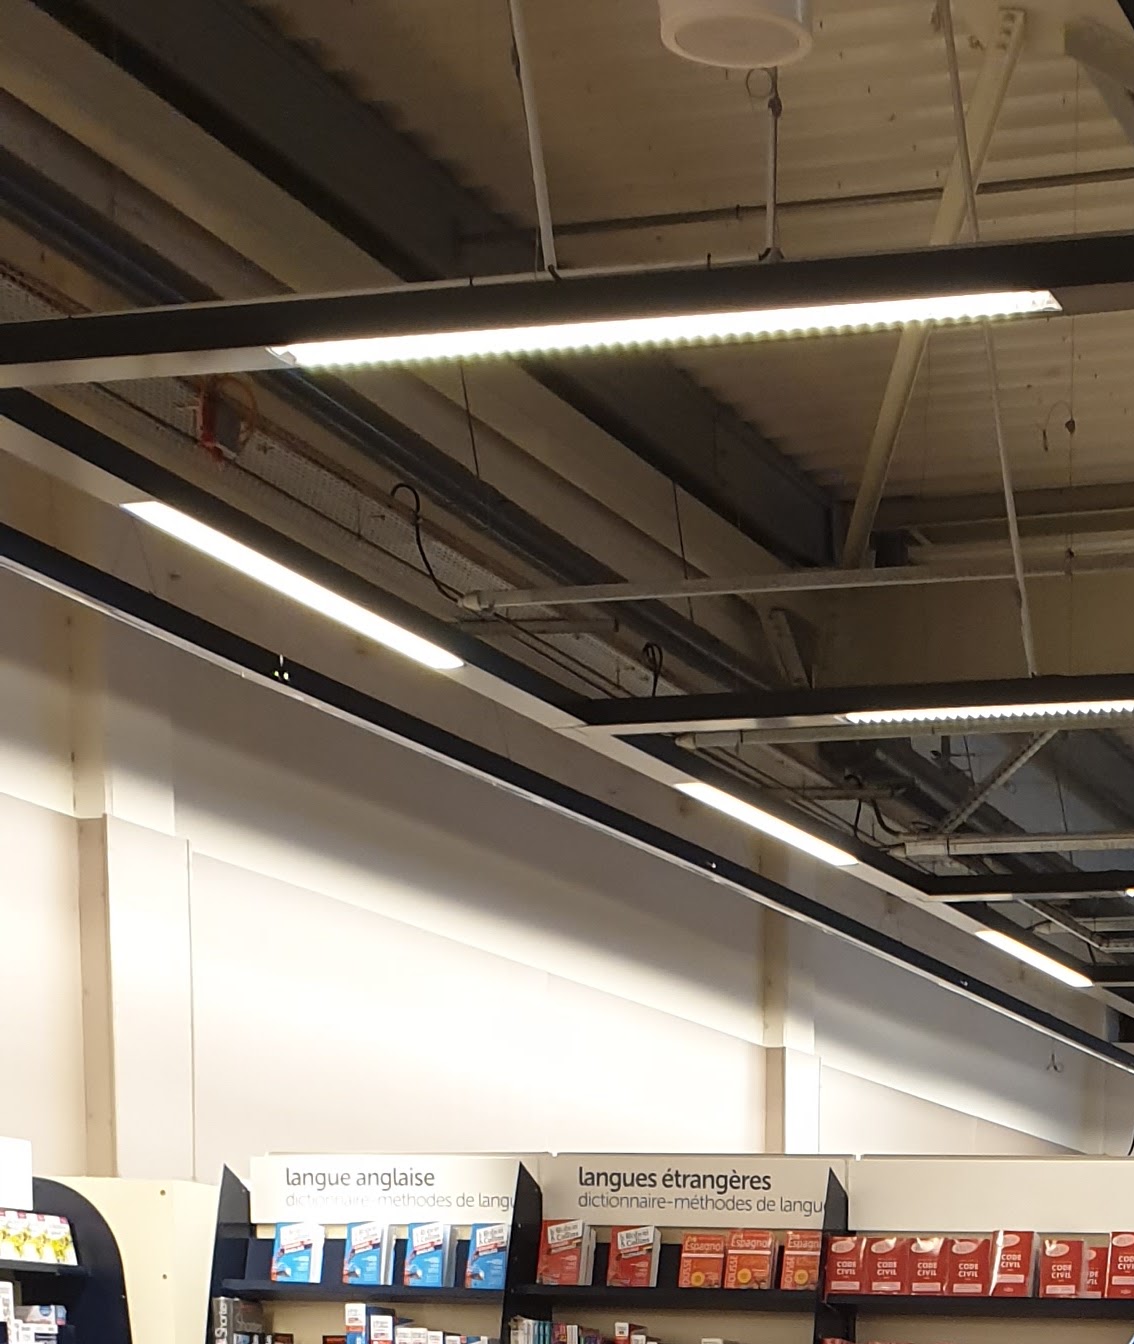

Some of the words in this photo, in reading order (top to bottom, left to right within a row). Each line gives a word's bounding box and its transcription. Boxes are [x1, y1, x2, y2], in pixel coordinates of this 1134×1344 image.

[286, 1168, 351, 1191] langue
[357, 1168, 435, 1191] anglaise
[579, 1166, 657, 1191] langues
[662, 1169, 771, 1194] étrangères
[456, 1193, 474, 1207] de
[478, 1193, 515, 1211] langu
[578, 1192, 752, 1212] dictionnaire-méthodes
[756, 1194, 776, 1212] de
[780, 1196, 826, 1217] langu
